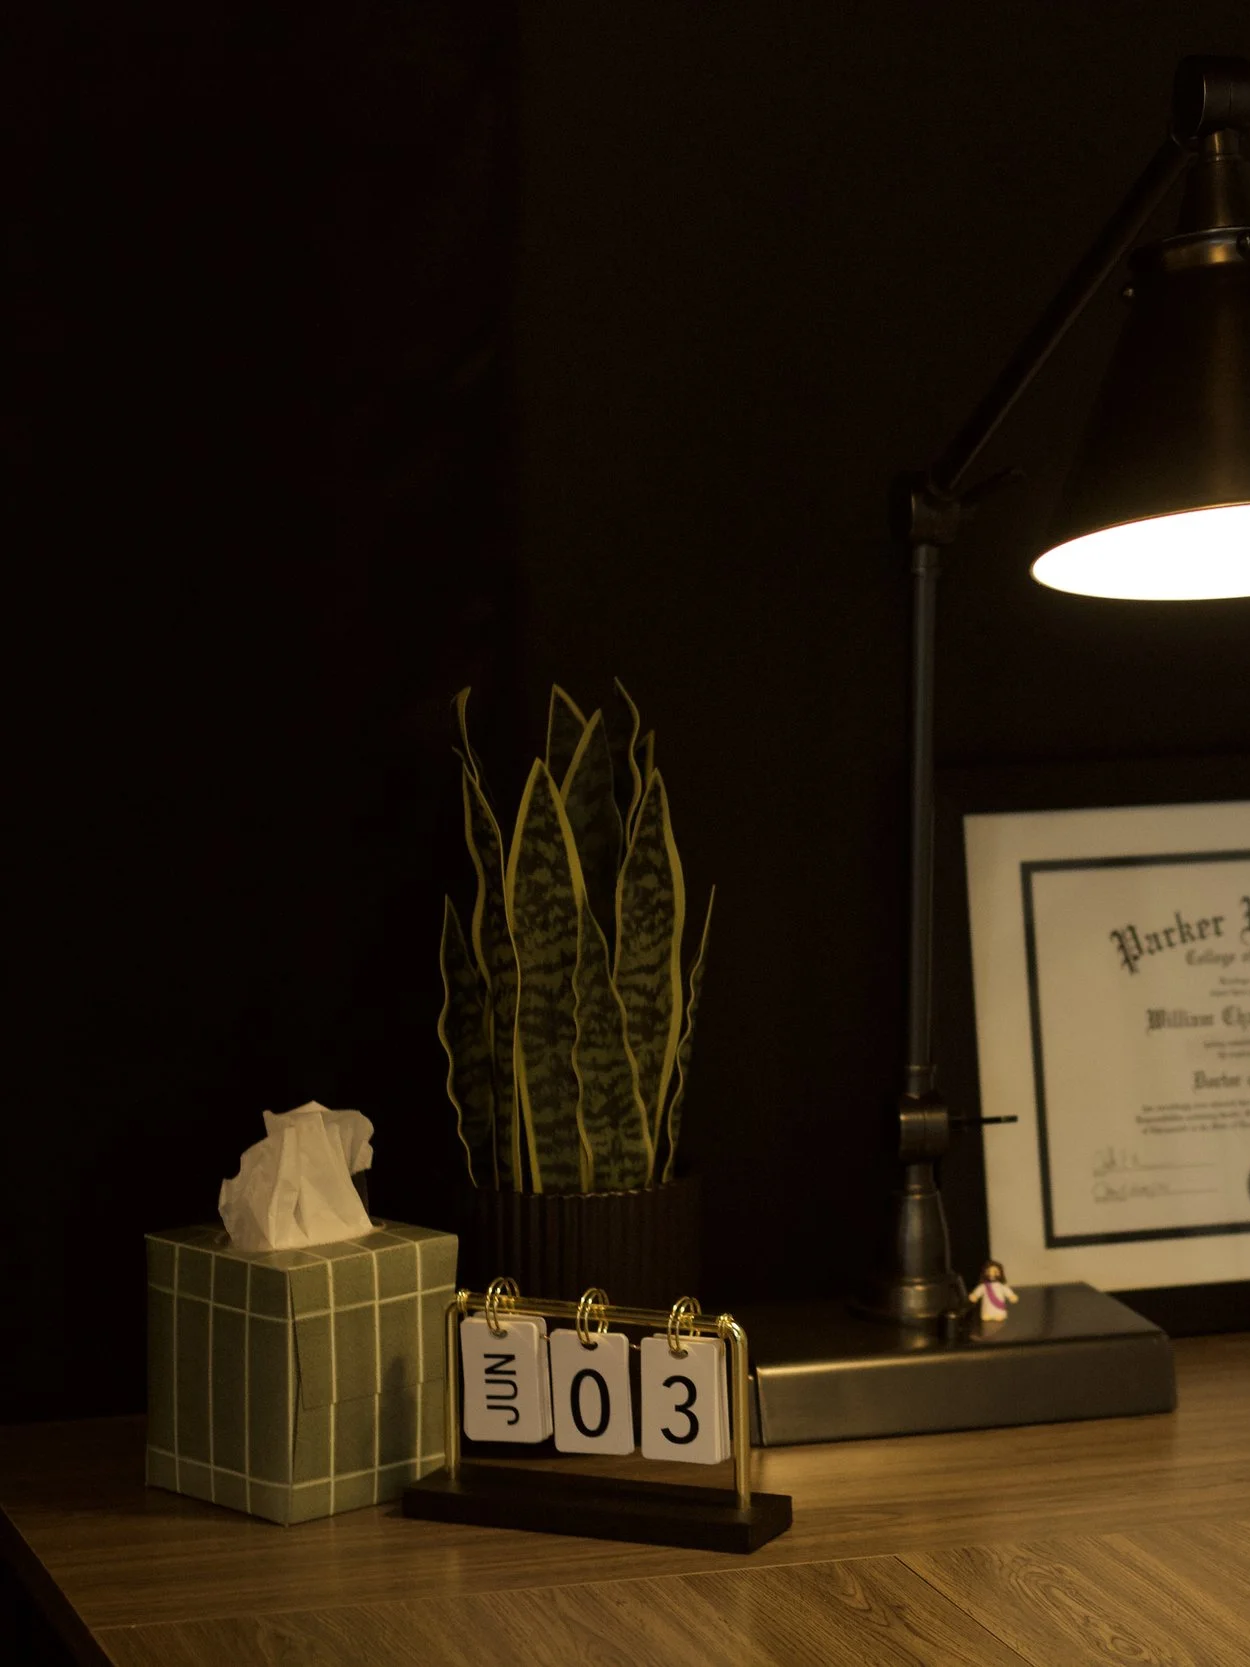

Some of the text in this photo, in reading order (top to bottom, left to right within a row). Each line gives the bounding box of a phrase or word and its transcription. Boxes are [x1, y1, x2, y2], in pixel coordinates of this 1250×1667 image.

[1109, 909, 1226, 976] Parker
[1185, 947, 1235, 968] College
[1146, 1007, 1215, 1034] William
[484, 1353, 520, 1426] JUN
